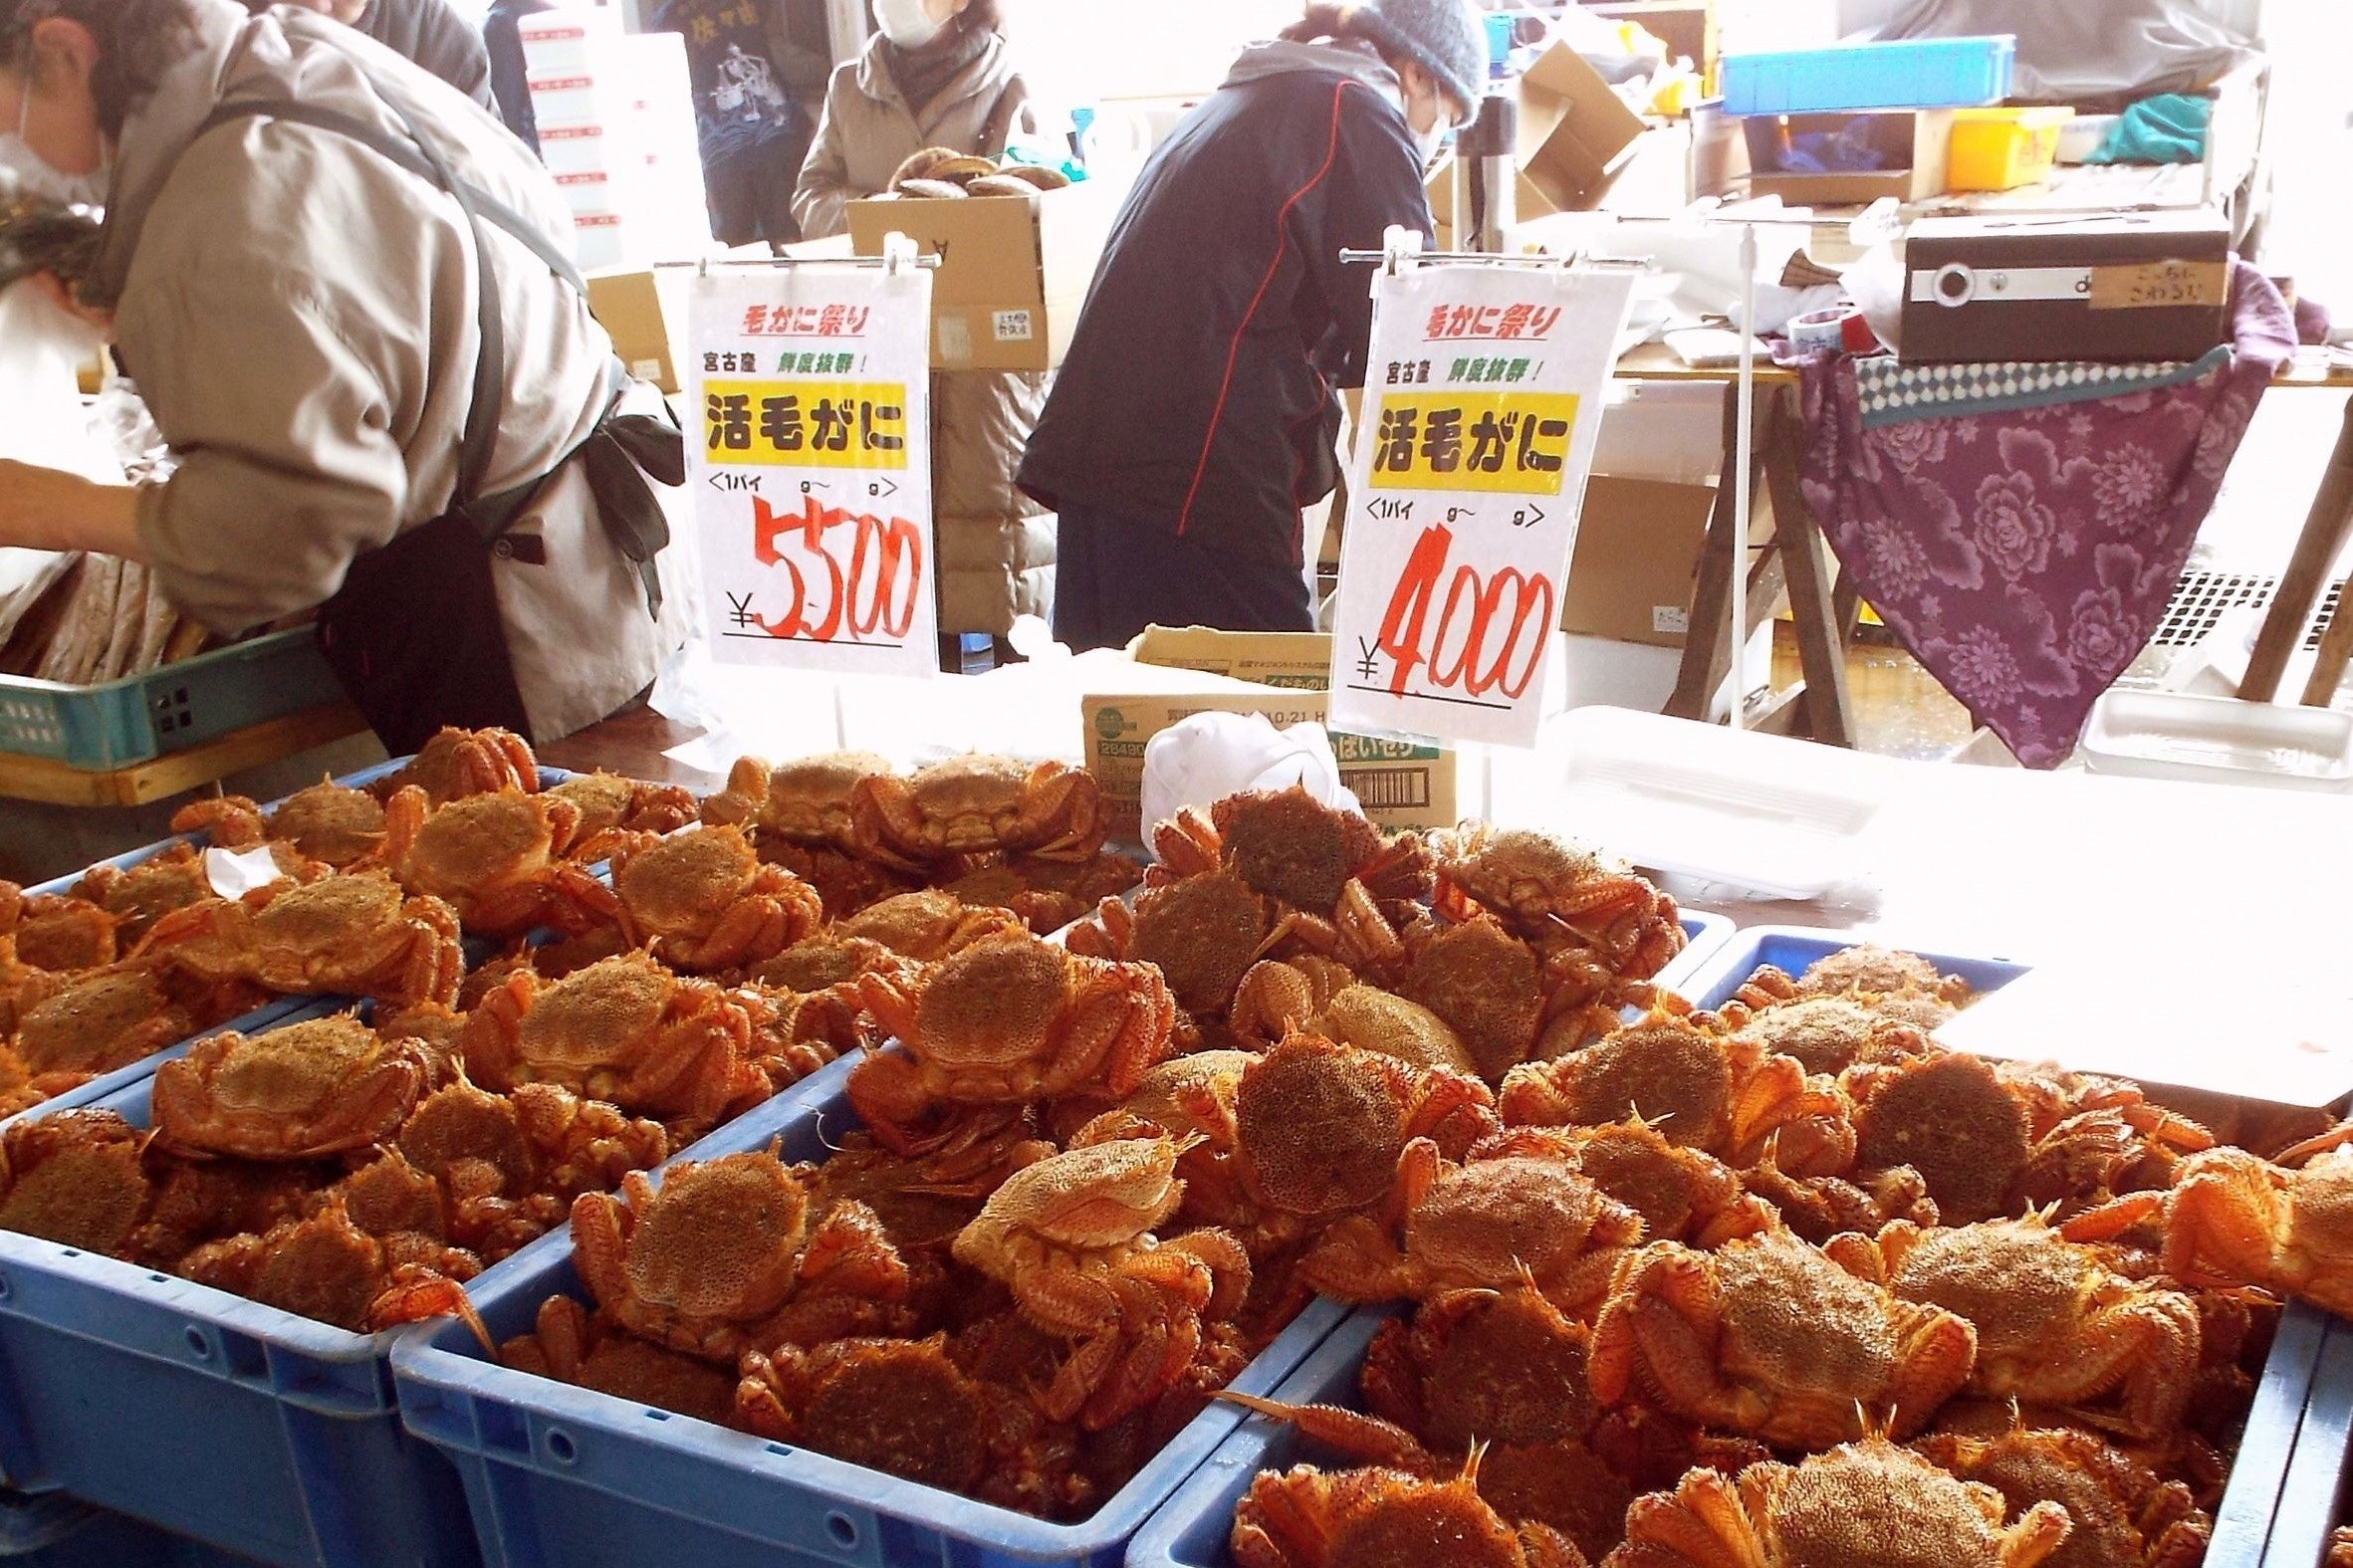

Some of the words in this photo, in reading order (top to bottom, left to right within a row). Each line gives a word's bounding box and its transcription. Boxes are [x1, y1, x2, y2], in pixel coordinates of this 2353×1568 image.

[743, 304, 869, 336] 毛かに祭り
[1426, 303, 1561, 339] 毛かに祭り
[703, 351, 757, 373] 宮古産
[1385, 358, 1431, 385] 宮古産
[707, 393, 904, 451] 活毛がに
[1373, 407, 1568, 474] 活毛がに
